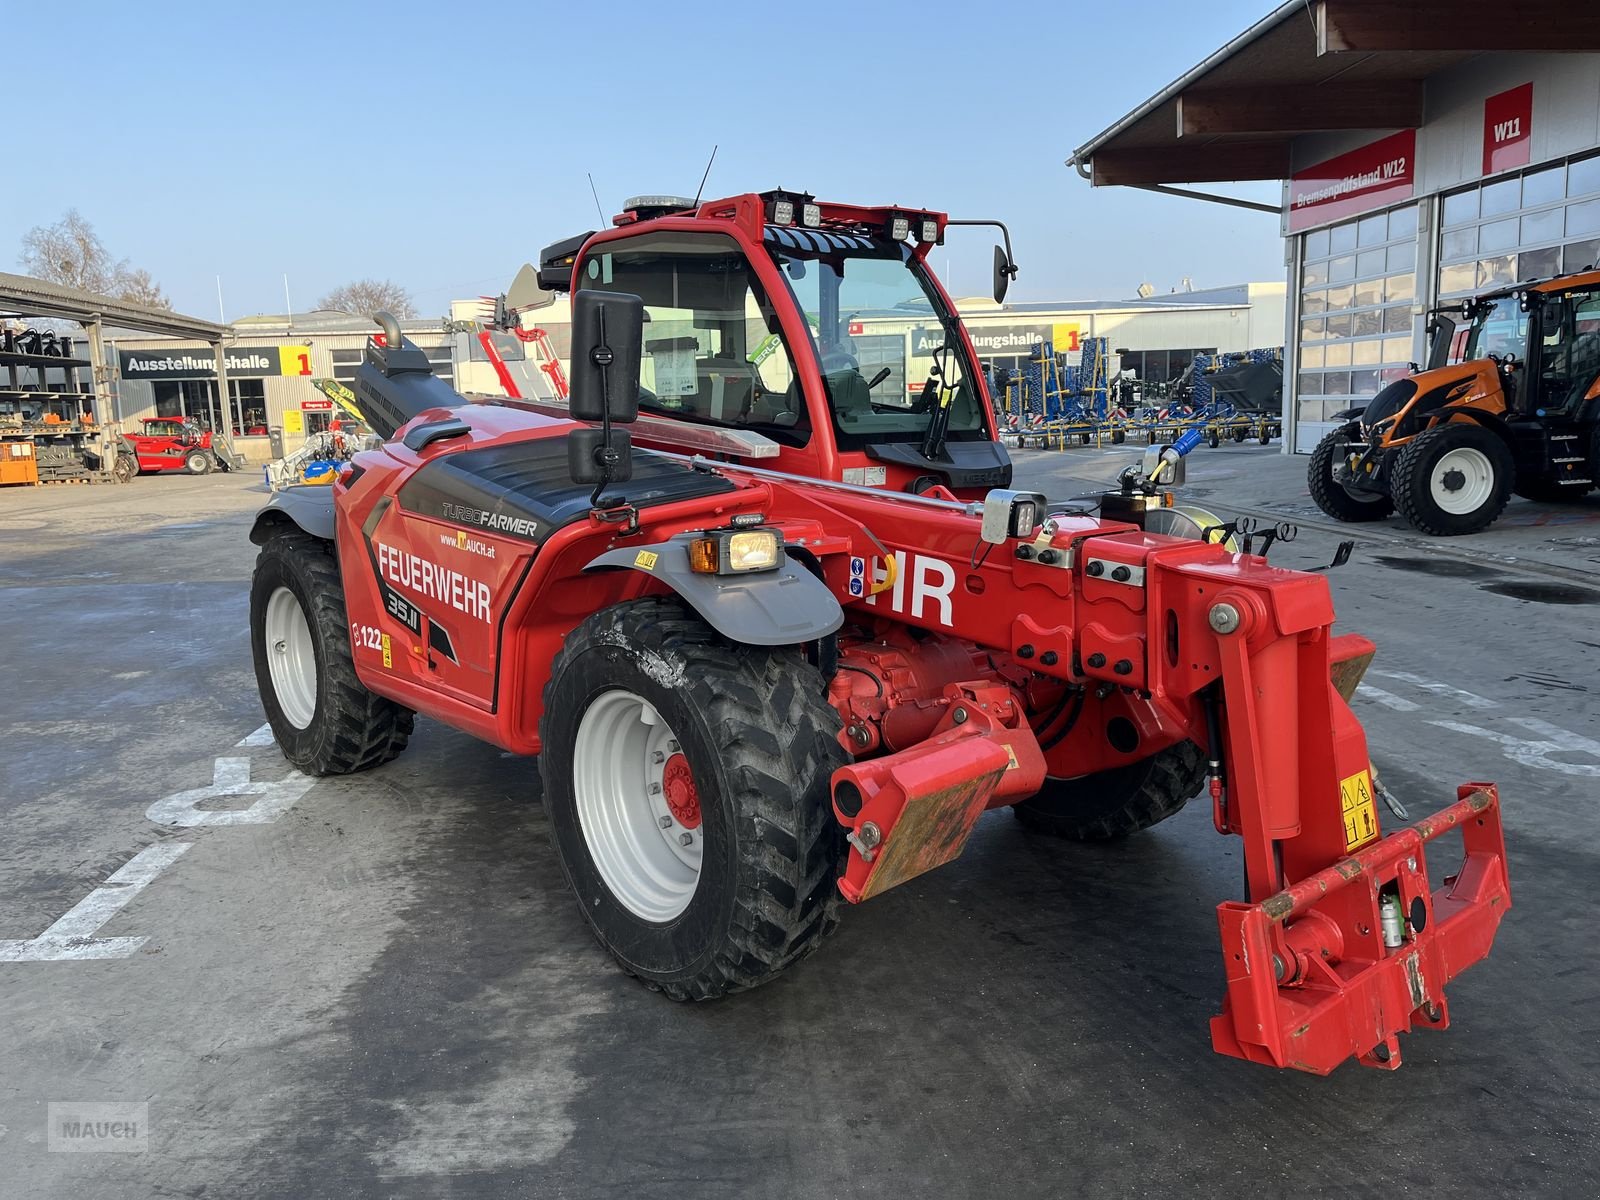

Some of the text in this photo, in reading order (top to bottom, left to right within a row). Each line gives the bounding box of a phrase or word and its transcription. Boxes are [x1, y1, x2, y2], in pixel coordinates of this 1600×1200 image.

[1493, 117, 1521, 143] W11
[1297, 157, 1406, 207] Bremsenprüfstand W12
[1068, 330, 1080, 351] 1
[297, 353, 312, 376] 1
[442, 502, 538, 537] TURBOFARMER
[379, 542, 492, 625] FEUERWEHR
[388, 592, 417, 630] 35.11
[360, 625, 383, 651] 122
